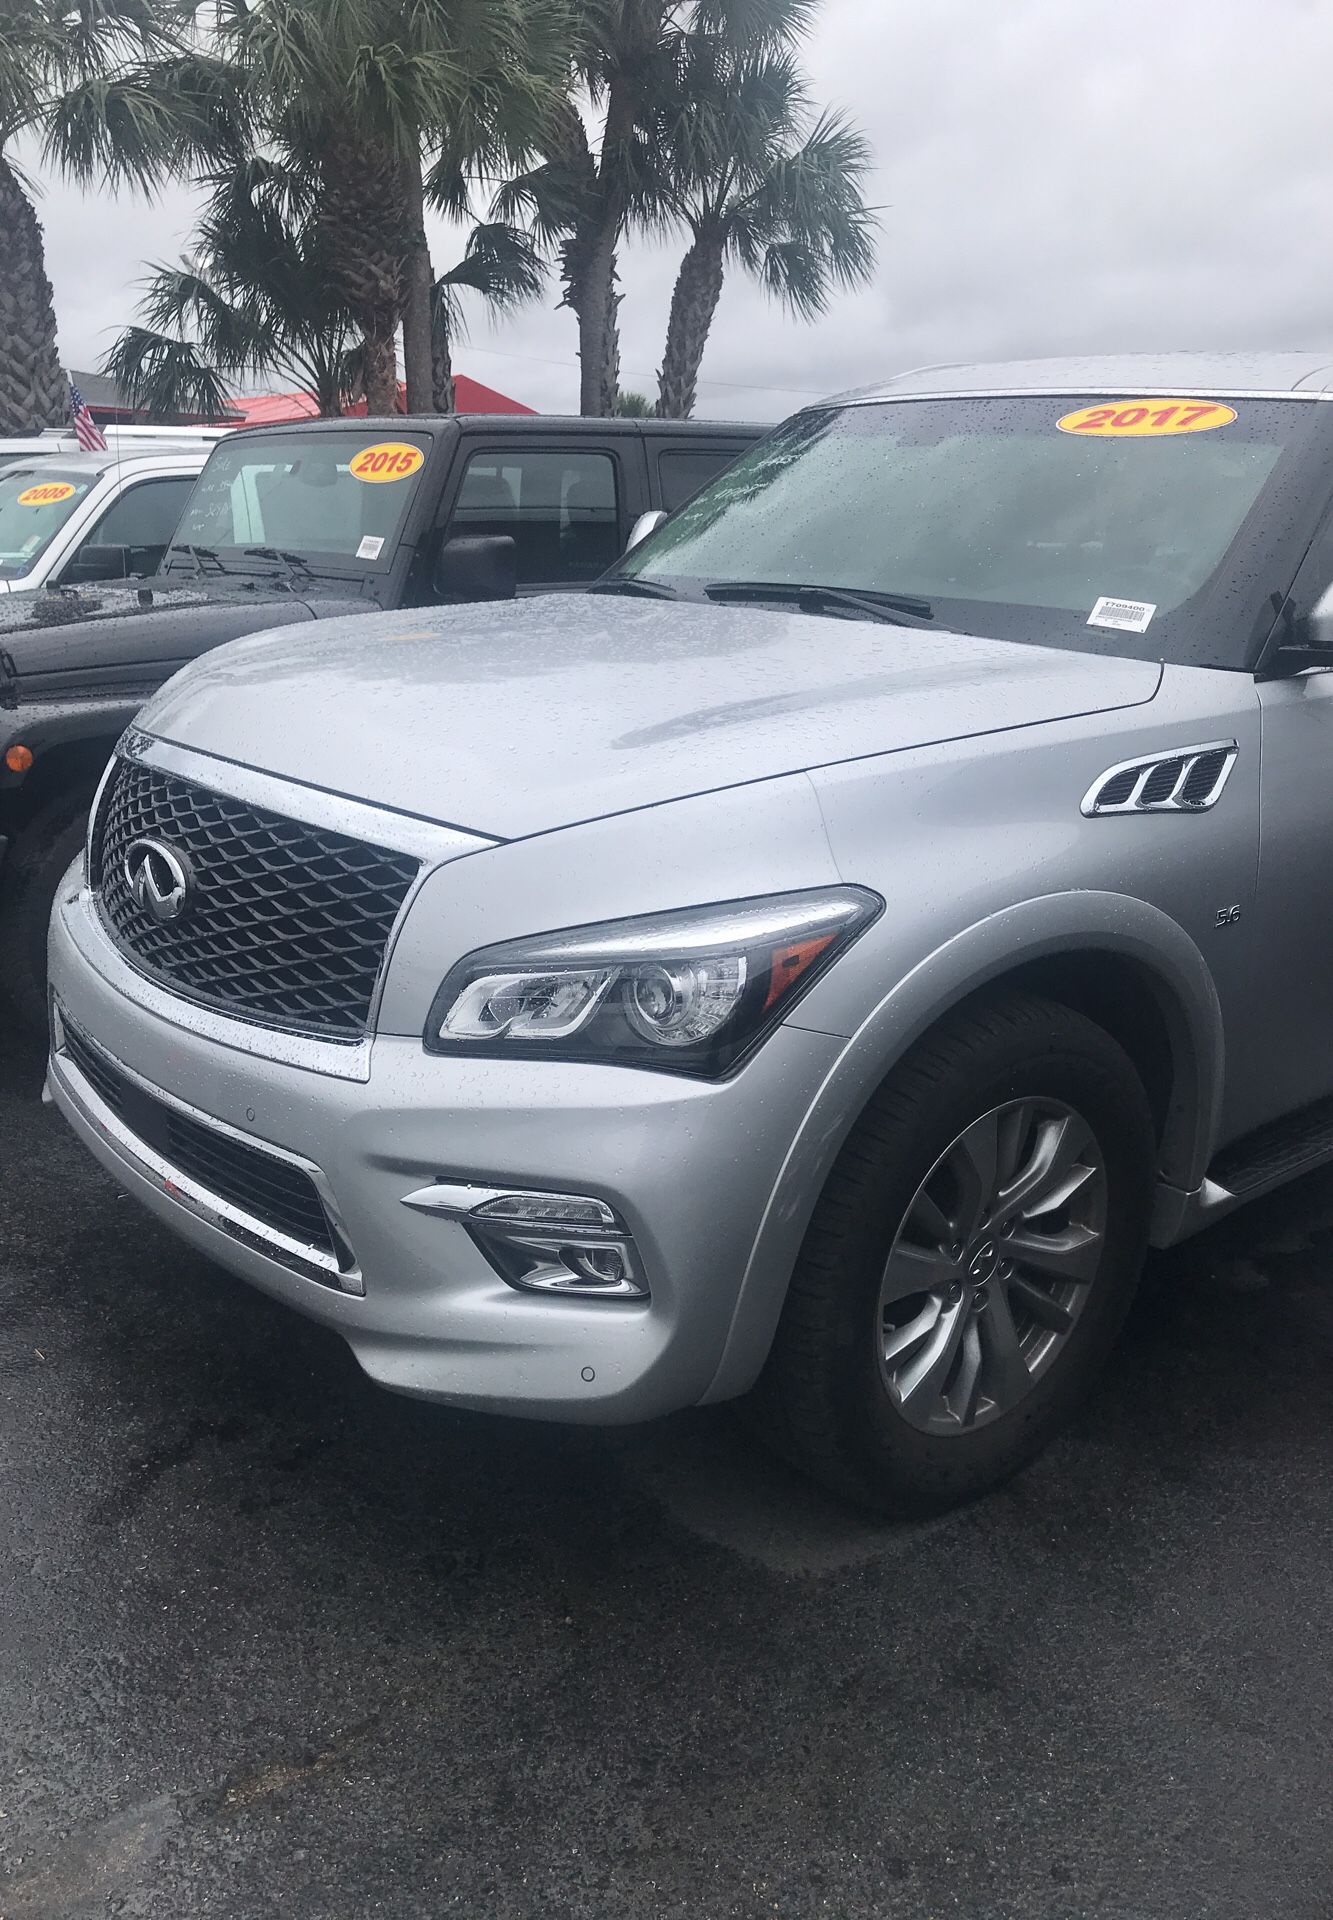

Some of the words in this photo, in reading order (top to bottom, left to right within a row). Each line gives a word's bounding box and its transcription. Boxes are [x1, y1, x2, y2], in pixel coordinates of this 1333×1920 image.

[1071, 406, 1219, 430] 2017
[355, 452, 418, 473] 2015
[20, 487, 71, 502] 2008
